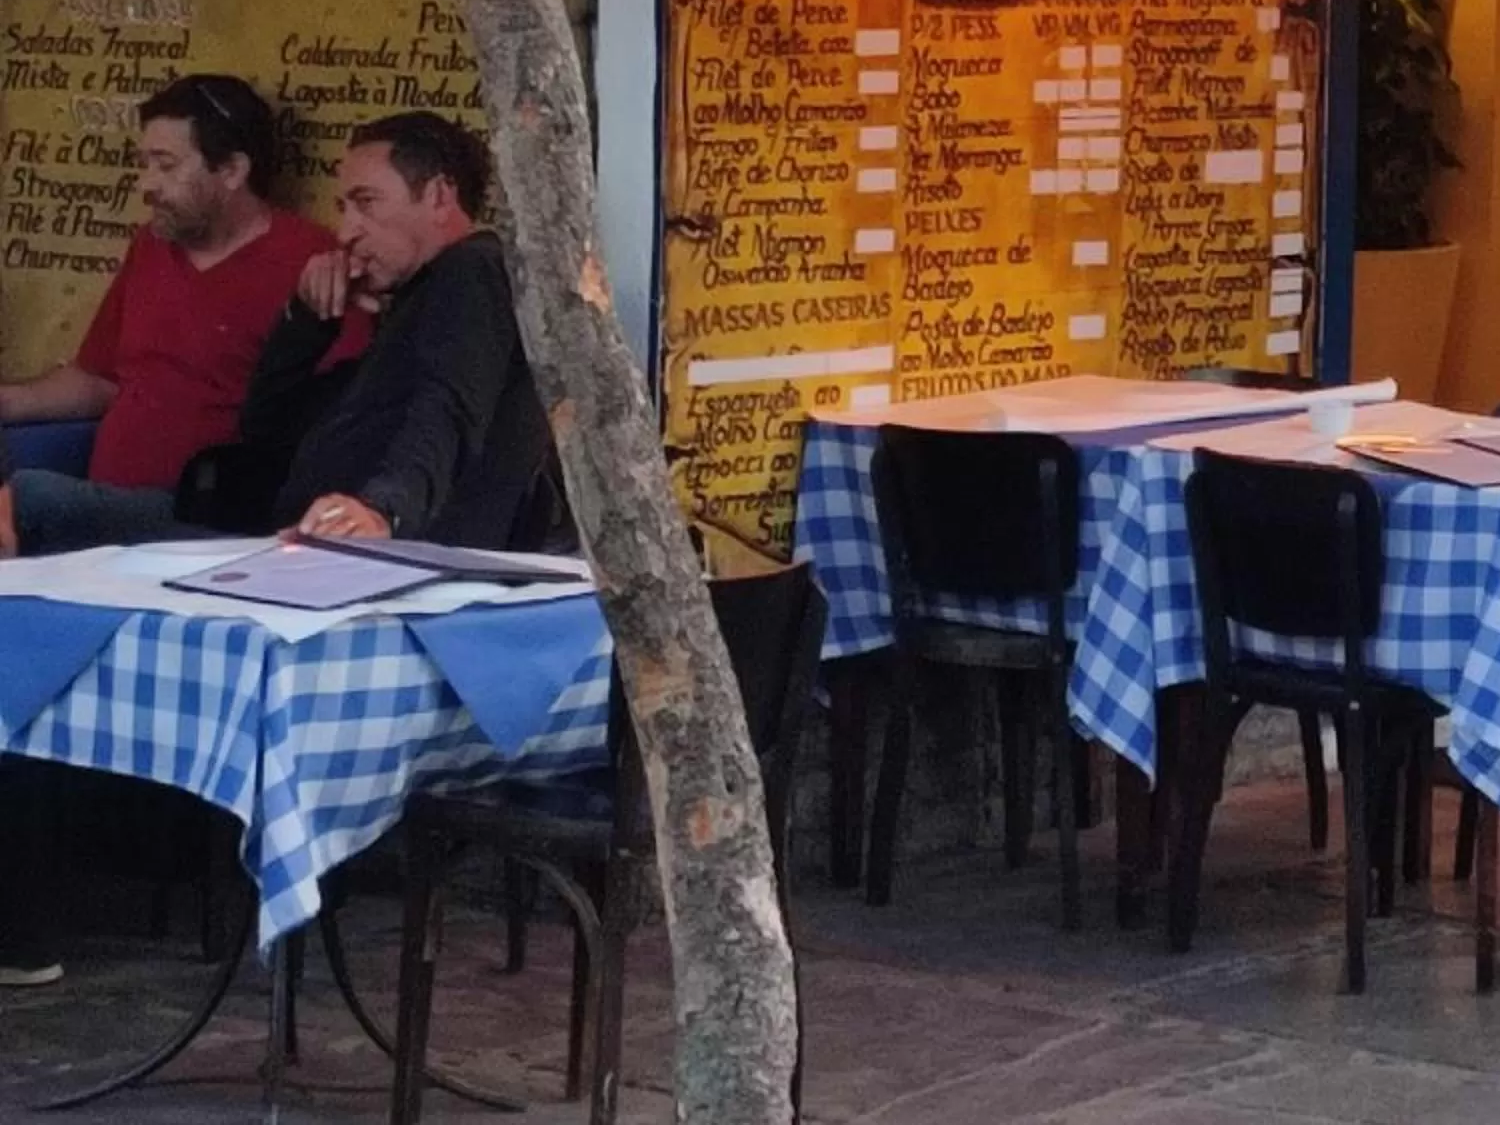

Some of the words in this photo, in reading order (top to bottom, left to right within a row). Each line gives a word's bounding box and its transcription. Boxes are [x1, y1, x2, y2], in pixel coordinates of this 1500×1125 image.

[5, 22, 95, 57] Saladas
[2, 58, 70, 91] Mista
[103, 61, 180, 95] Palmit
[391, 76, 459, 109] Moda
[3, 128, 51, 165] Filé
[6, 202, 46, 235] Filé
[1006, 232, 1034, 266] de
[683, 300, 785, 338] MASSAS
[790, 289, 893, 324] CASEIRAS
[814, 383, 842, 406] ao
[690, 477, 797, 520] Sorrentin
